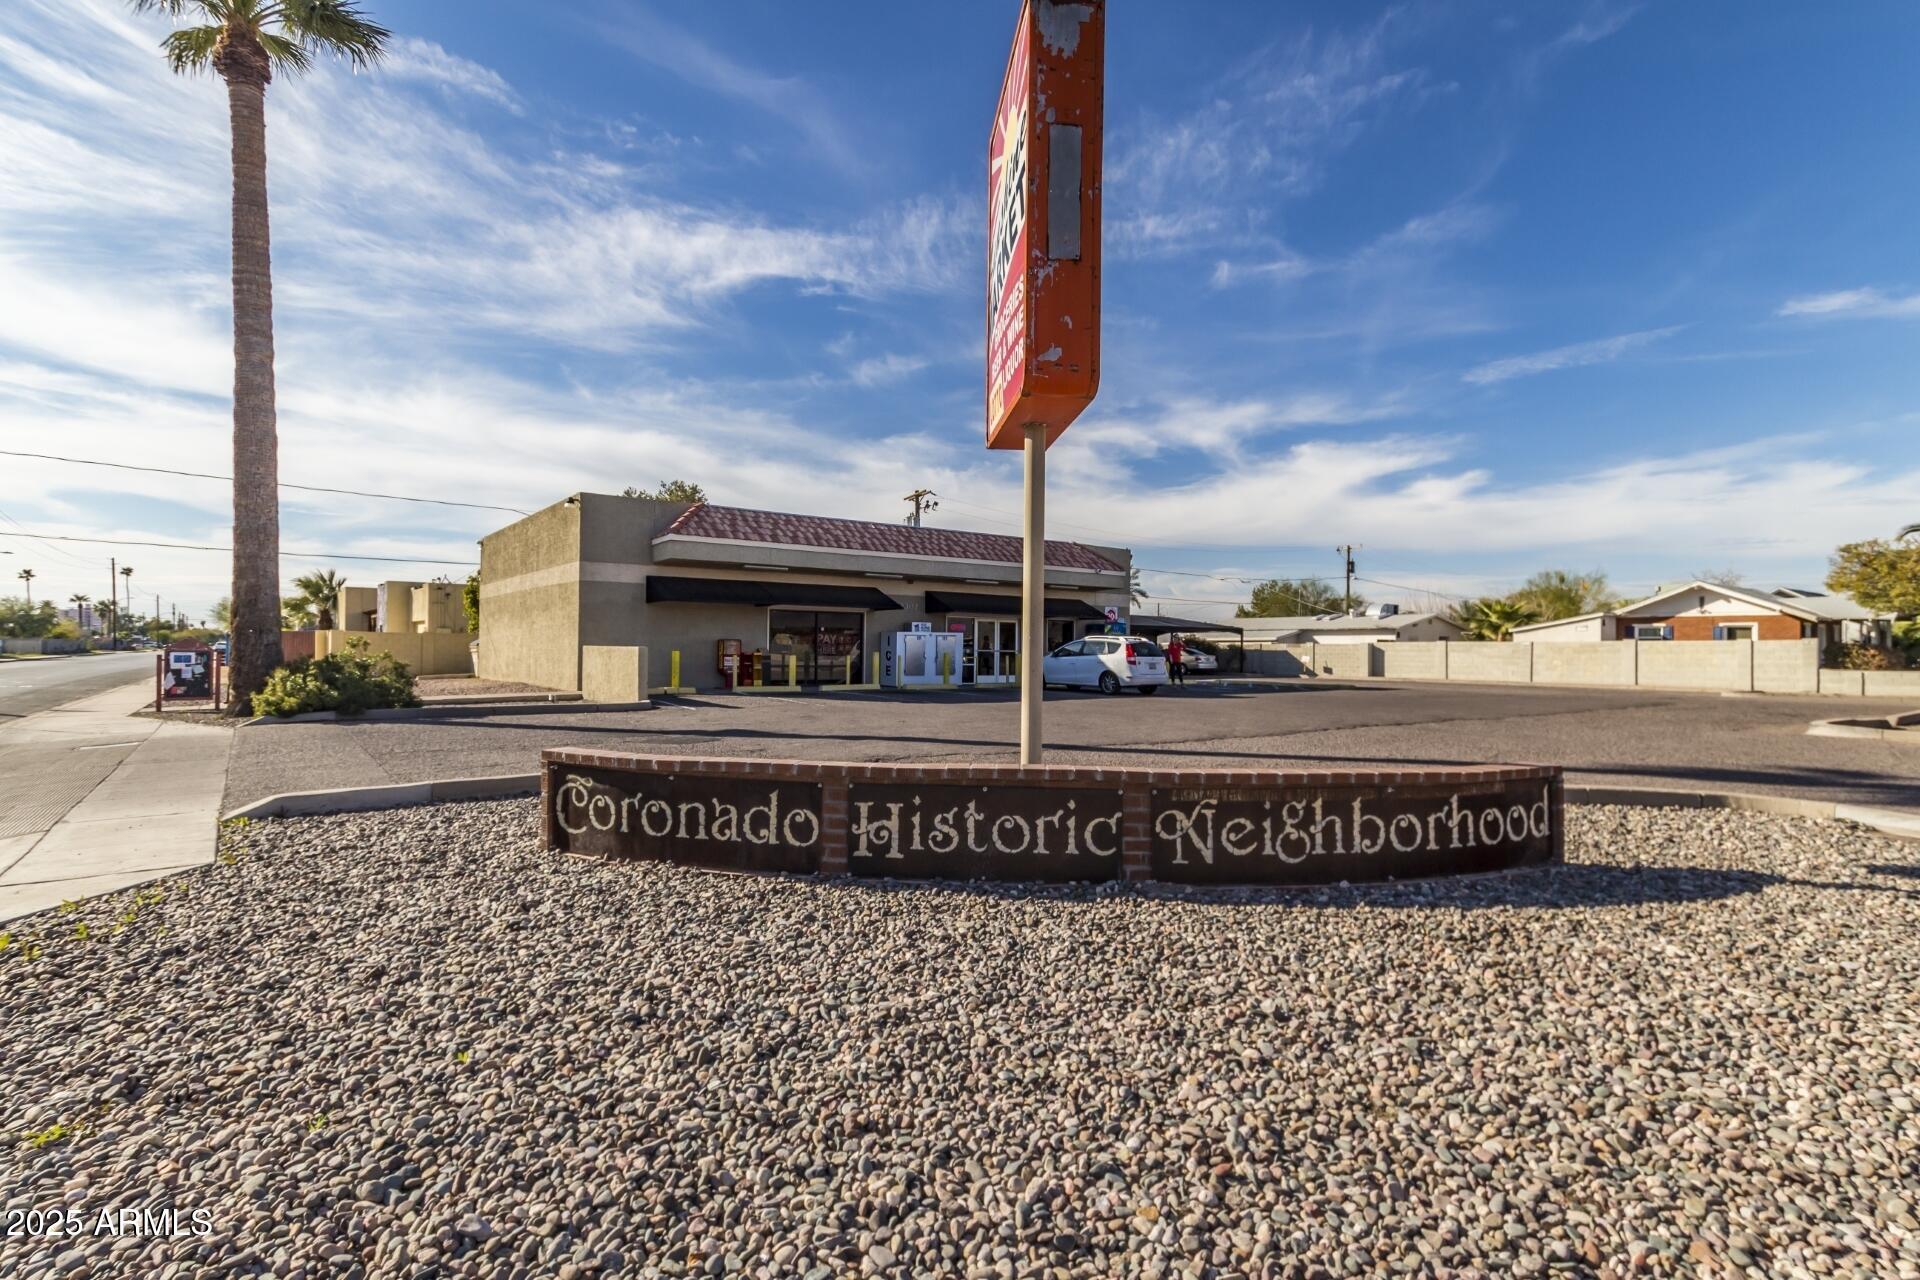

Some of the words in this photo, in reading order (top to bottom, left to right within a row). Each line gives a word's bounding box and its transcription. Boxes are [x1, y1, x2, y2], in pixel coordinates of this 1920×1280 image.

[1007, 303, 1024, 351] WINE
[1002, 336, 1024, 391] LIQUOR
[817, 633, 837, 644] PAY
[555, 774, 819, 848] Coronado
[852, 794, 1123, 859] Historic
[1155, 783, 1551, 865] Neighborhood
